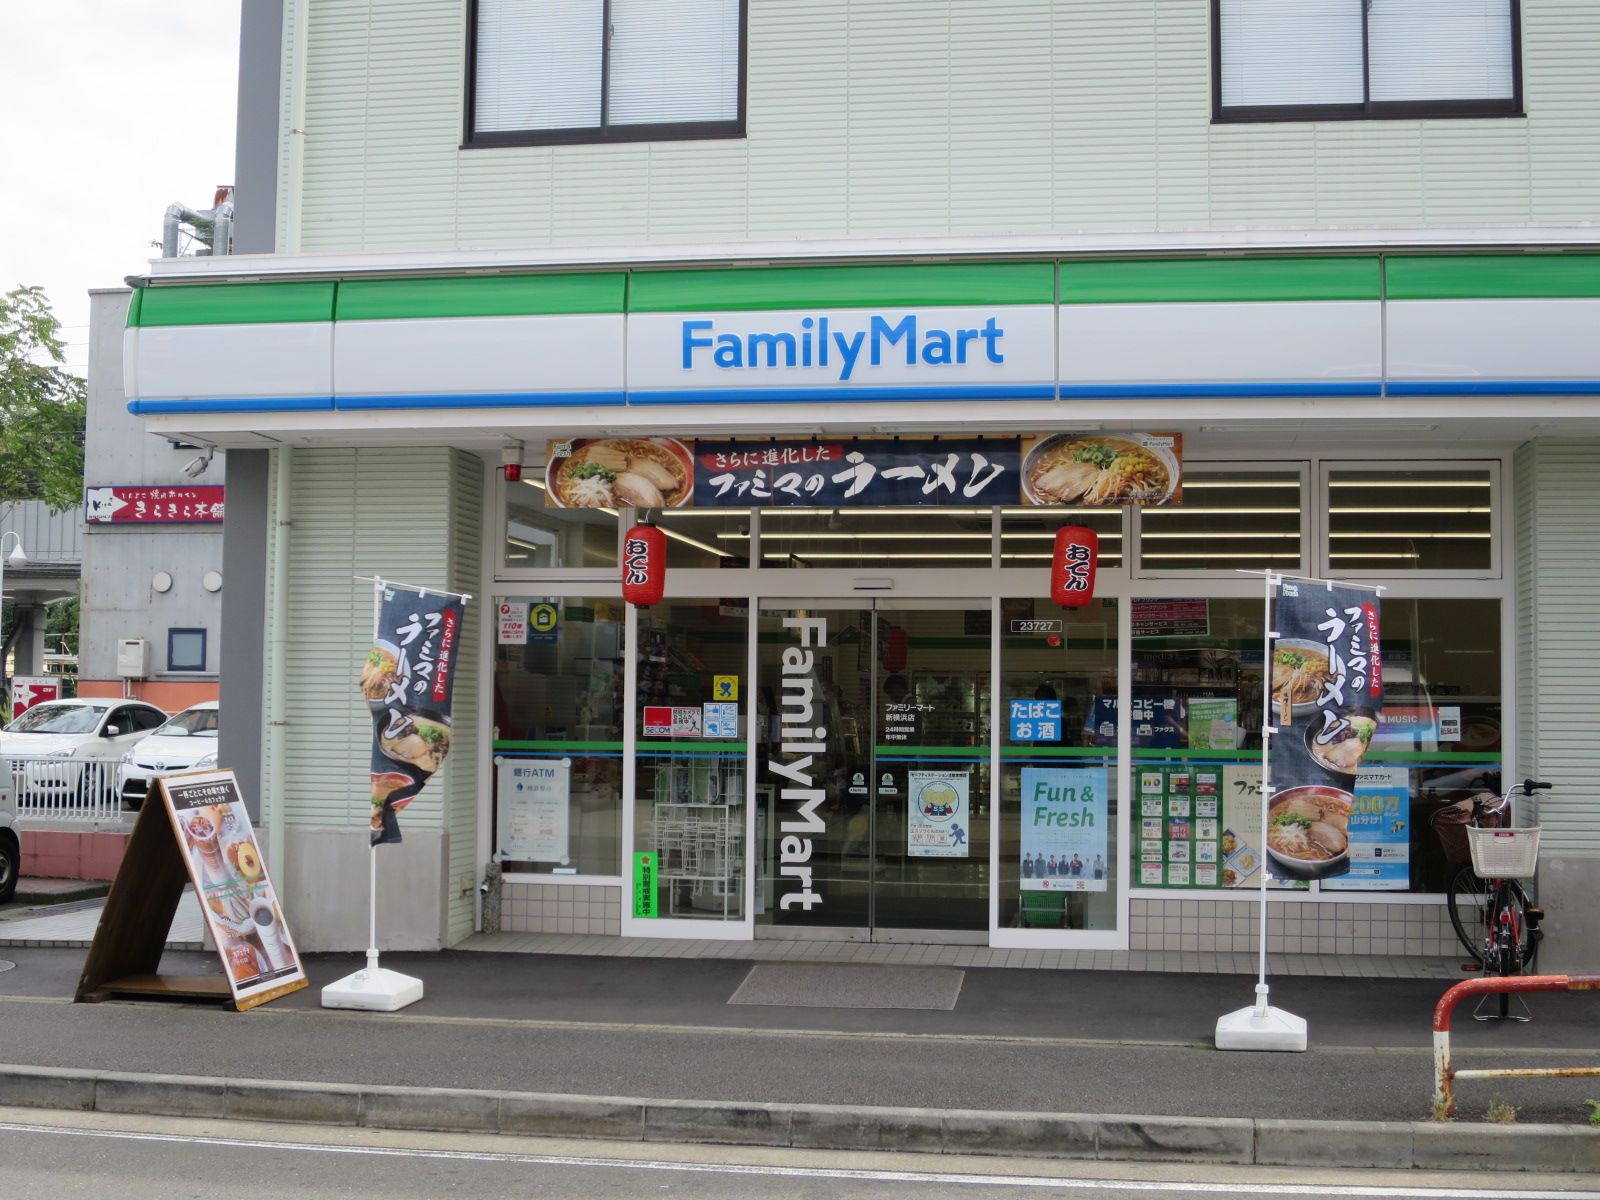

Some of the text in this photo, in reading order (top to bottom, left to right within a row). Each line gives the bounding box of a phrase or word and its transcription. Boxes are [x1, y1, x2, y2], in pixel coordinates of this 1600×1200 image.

[682, 314, 1005, 380] FamilyMart
[715, 446, 831, 468] さらに進化した
[832, 451, 1005, 498] ラーメン
[708, 469, 825, 498] ファミマの
[626, 539, 648, 585] おでん
[1064, 543, 1091, 591] おでん
[1020, 621, 1054, 631] 23727
[412, 612, 443, 696] ファミマの
[434, 617, 455, 695] さらに進化した
[1344, 606, 1368, 693] ファミマの
[1367, 610, 1381, 688] さらに進化した
[383, 612, 423, 740] ラーメン
[1315, 607, 1351, 746] ラーメン
[885, 703, 936, 712] ファミリーマート
[885, 713, 916, 722] 新横浜店
[1011, 702, 1060, 719] たばこ
[1387, 715, 1418, 724] MUSIC
[1016, 722, 1055, 739] お酒
[513, 768, 555, 778] 銀行ATM
[768, 617, 827, 910] FamilyMart
[1034, 781, 1094, 802] Fun &
[1033, 806, 1095, 827] Fresh
